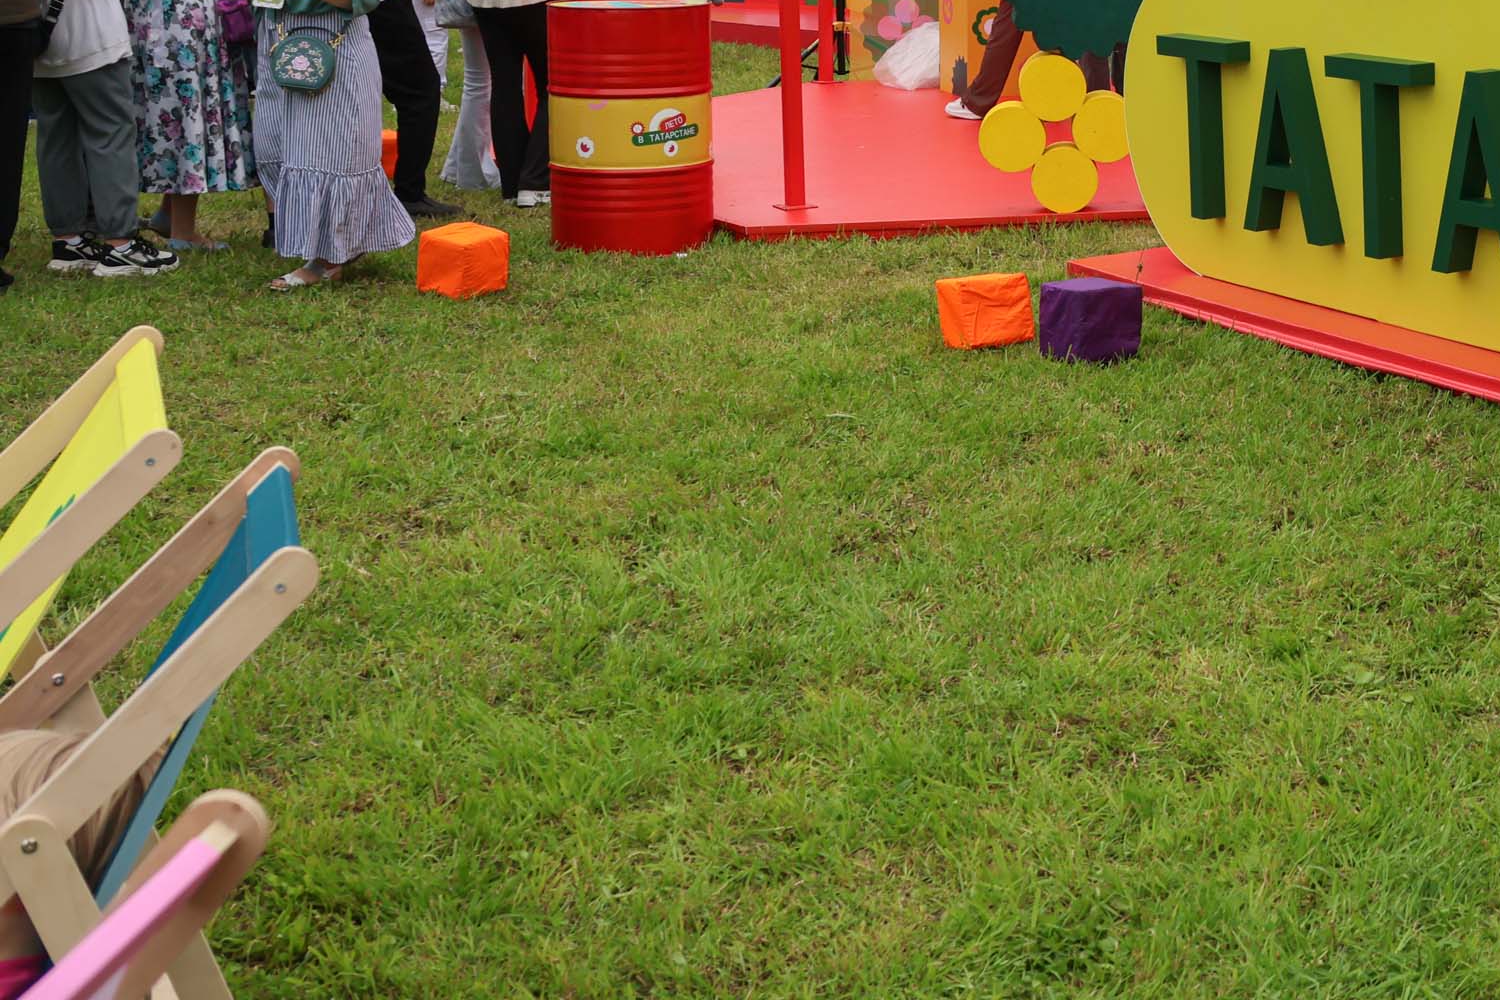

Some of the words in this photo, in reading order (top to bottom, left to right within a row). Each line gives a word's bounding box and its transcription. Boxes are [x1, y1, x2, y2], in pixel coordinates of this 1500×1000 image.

[664, 116, 683, 129] ЛЕТО
[637, 135, 645, 144] В
[649, 126, 696, 142] ТАТАРСТАНЕ
